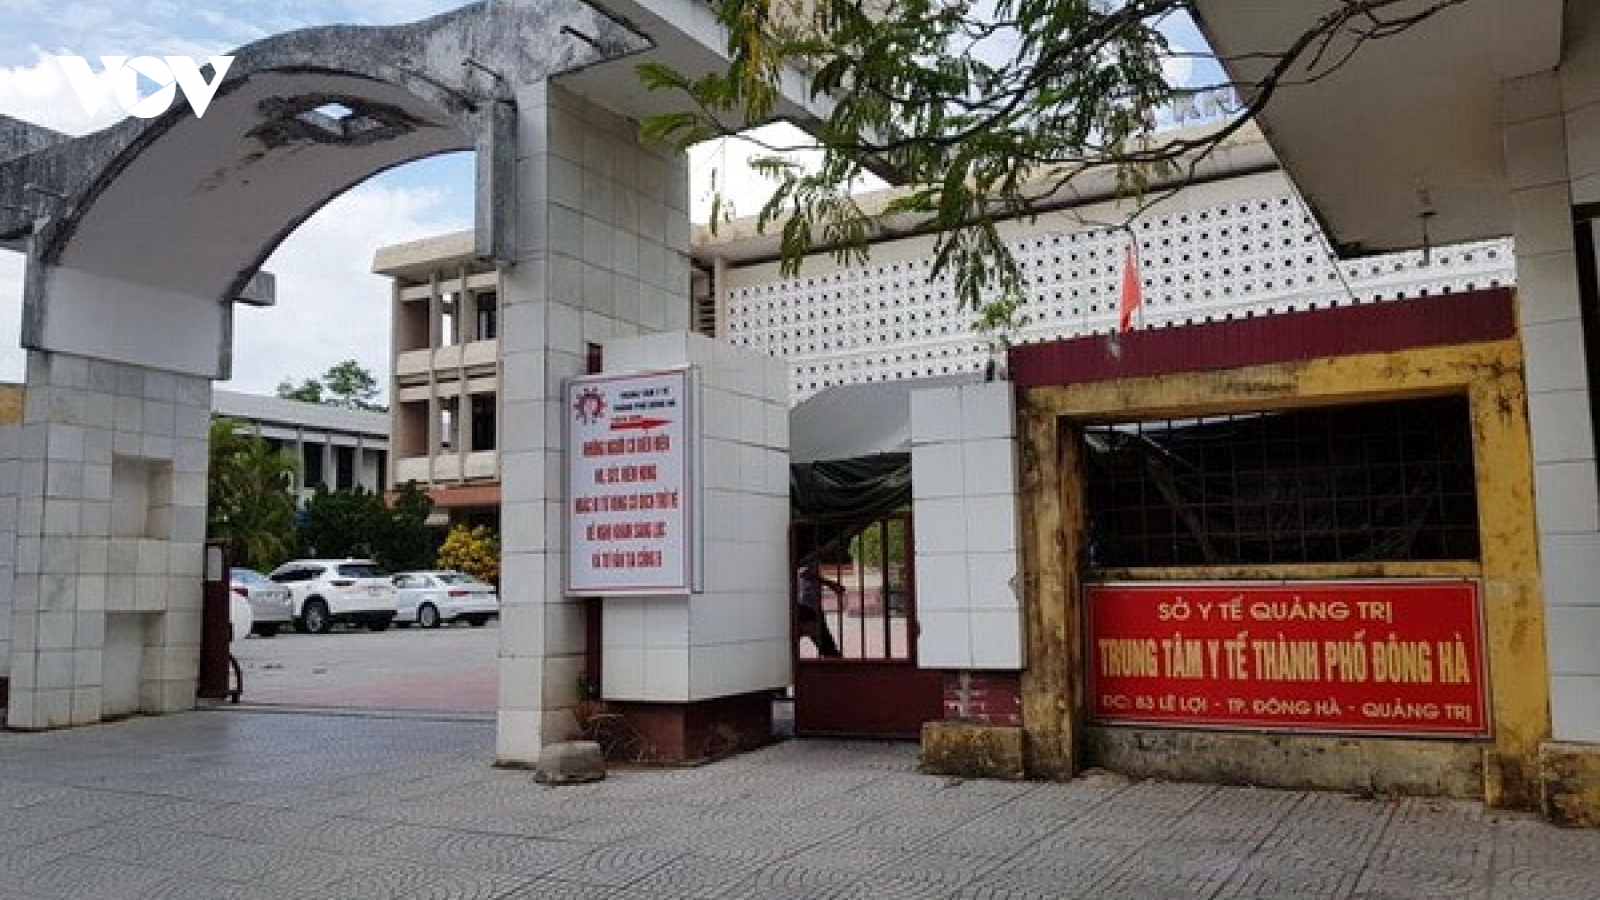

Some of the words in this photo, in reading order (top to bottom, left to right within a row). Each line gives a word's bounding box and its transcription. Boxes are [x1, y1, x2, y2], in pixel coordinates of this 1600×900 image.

[1197, 601, 1212, 621] Y
[1218, 594, 1243, 621] TẾ
[1250, 596, 1350, 622] QUẢNG
[1357, 601, 1393, 623] TRỊ
[1099, 638, 1158, 677] TRUNG
[1162, 631, 1204, 679] TÂM
[1207, 639, 1219, 679] Y
[1223, 631, 1249, 680] TẾ
[1252, 633, 1319, 682] THÀNH
[1324, 629, 1367, 682] PHỐ
[1372, 632, 1432, 683] ĐÔNG
[1437, 632, 1470, 684] HÀ
[1315, 698, 1342, 715] HÀ
[1444, 705, 1472, 722] TRỊ
